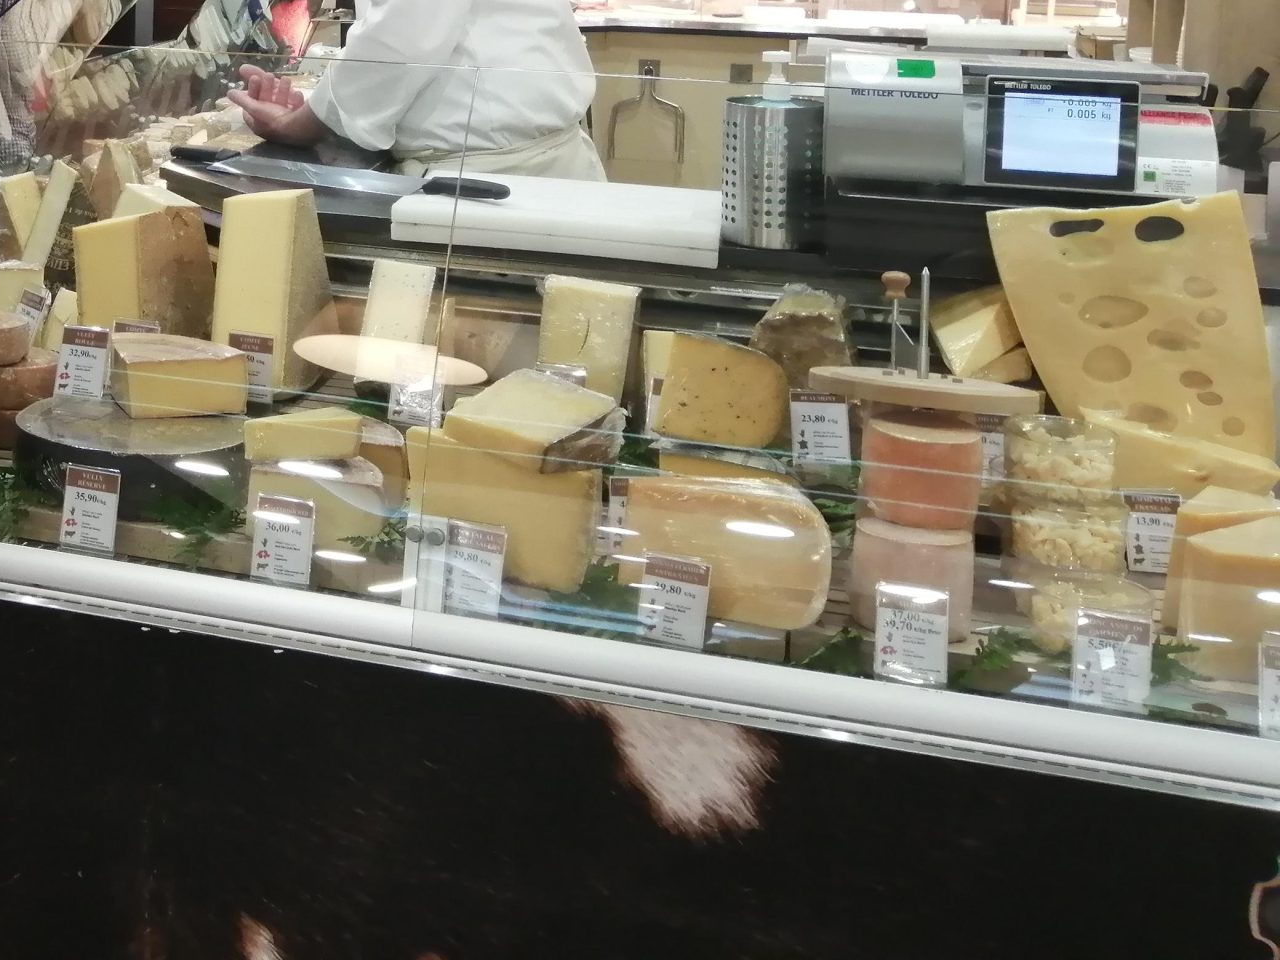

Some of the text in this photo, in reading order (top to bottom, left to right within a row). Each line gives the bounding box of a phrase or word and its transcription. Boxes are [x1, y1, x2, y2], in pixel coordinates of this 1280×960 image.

[851, 88, 939, 100] METTLER TOLEDO
[1067, 109, 1111, 120] 0.005 kg
[801, 414, 826, 424] 23,80
[265, 521, 290, 532] 36,00
[1136, 516, 1161, 526] 13,90
